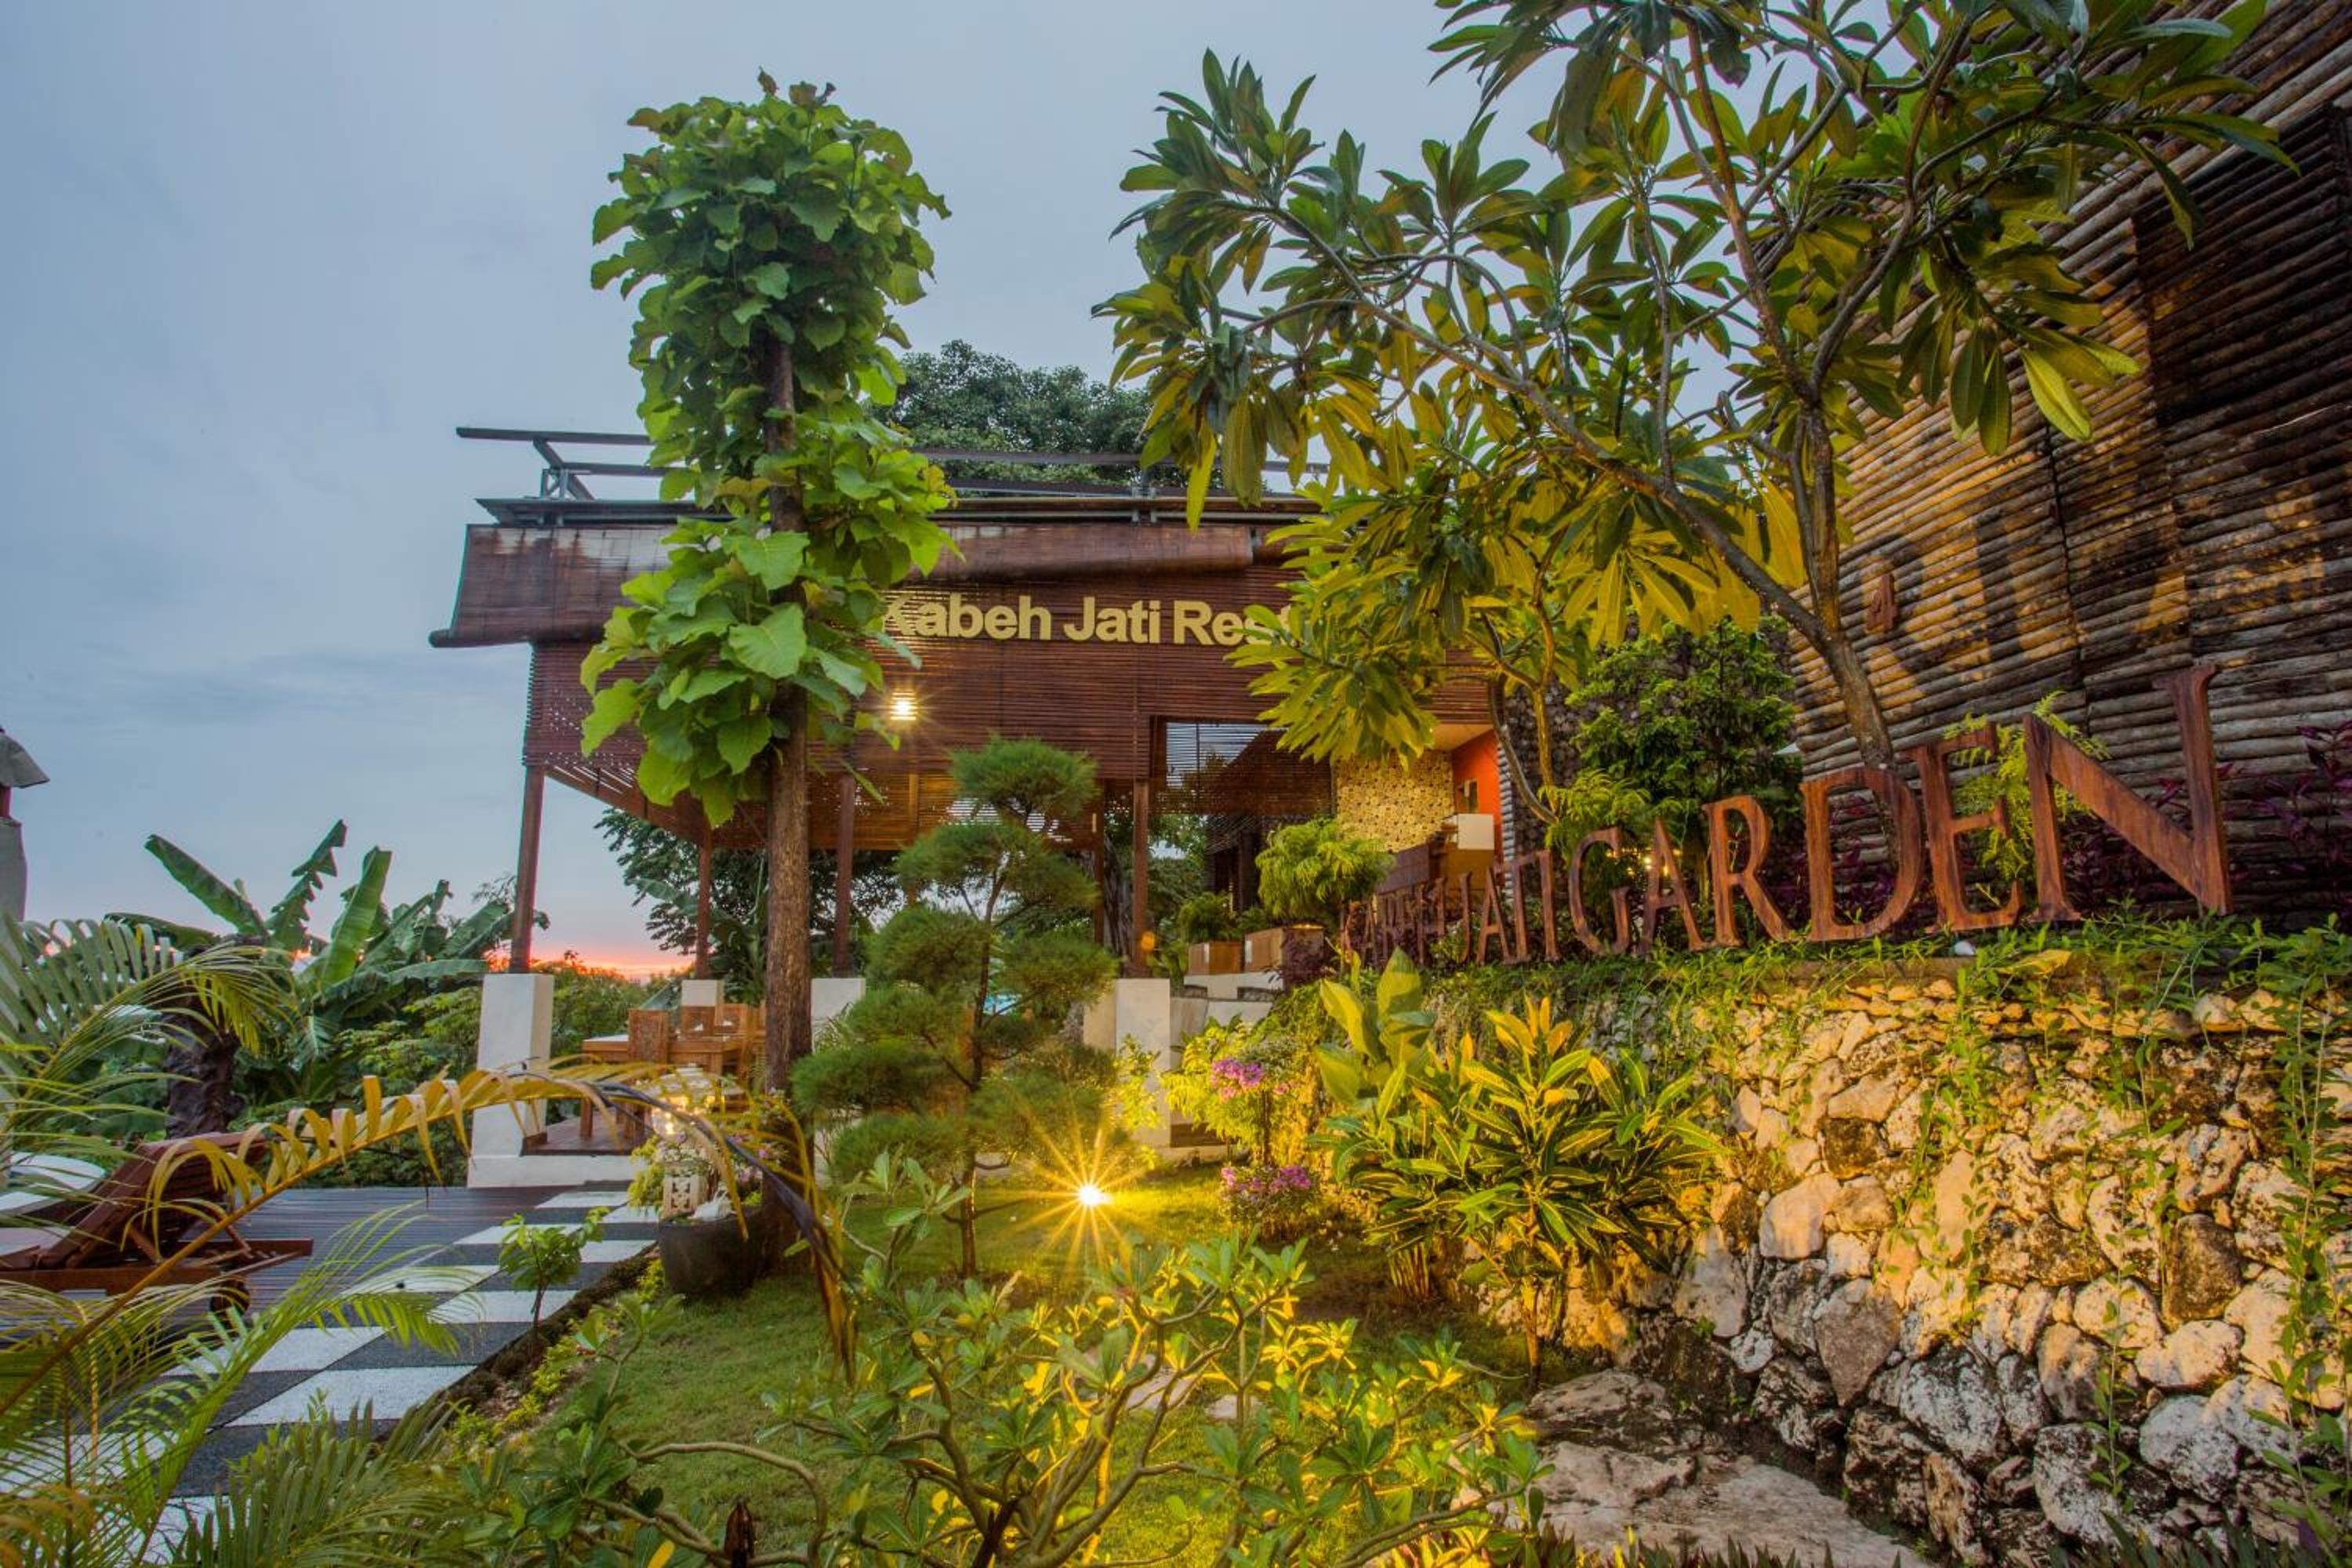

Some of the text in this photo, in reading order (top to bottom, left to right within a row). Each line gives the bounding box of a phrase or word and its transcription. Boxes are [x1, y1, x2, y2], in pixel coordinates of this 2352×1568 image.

[882, 592, 1052, 641] Kabeh
[1062, 596, 1162, 644] Jati
[1568, 663, 2234, 958] GARDEN
